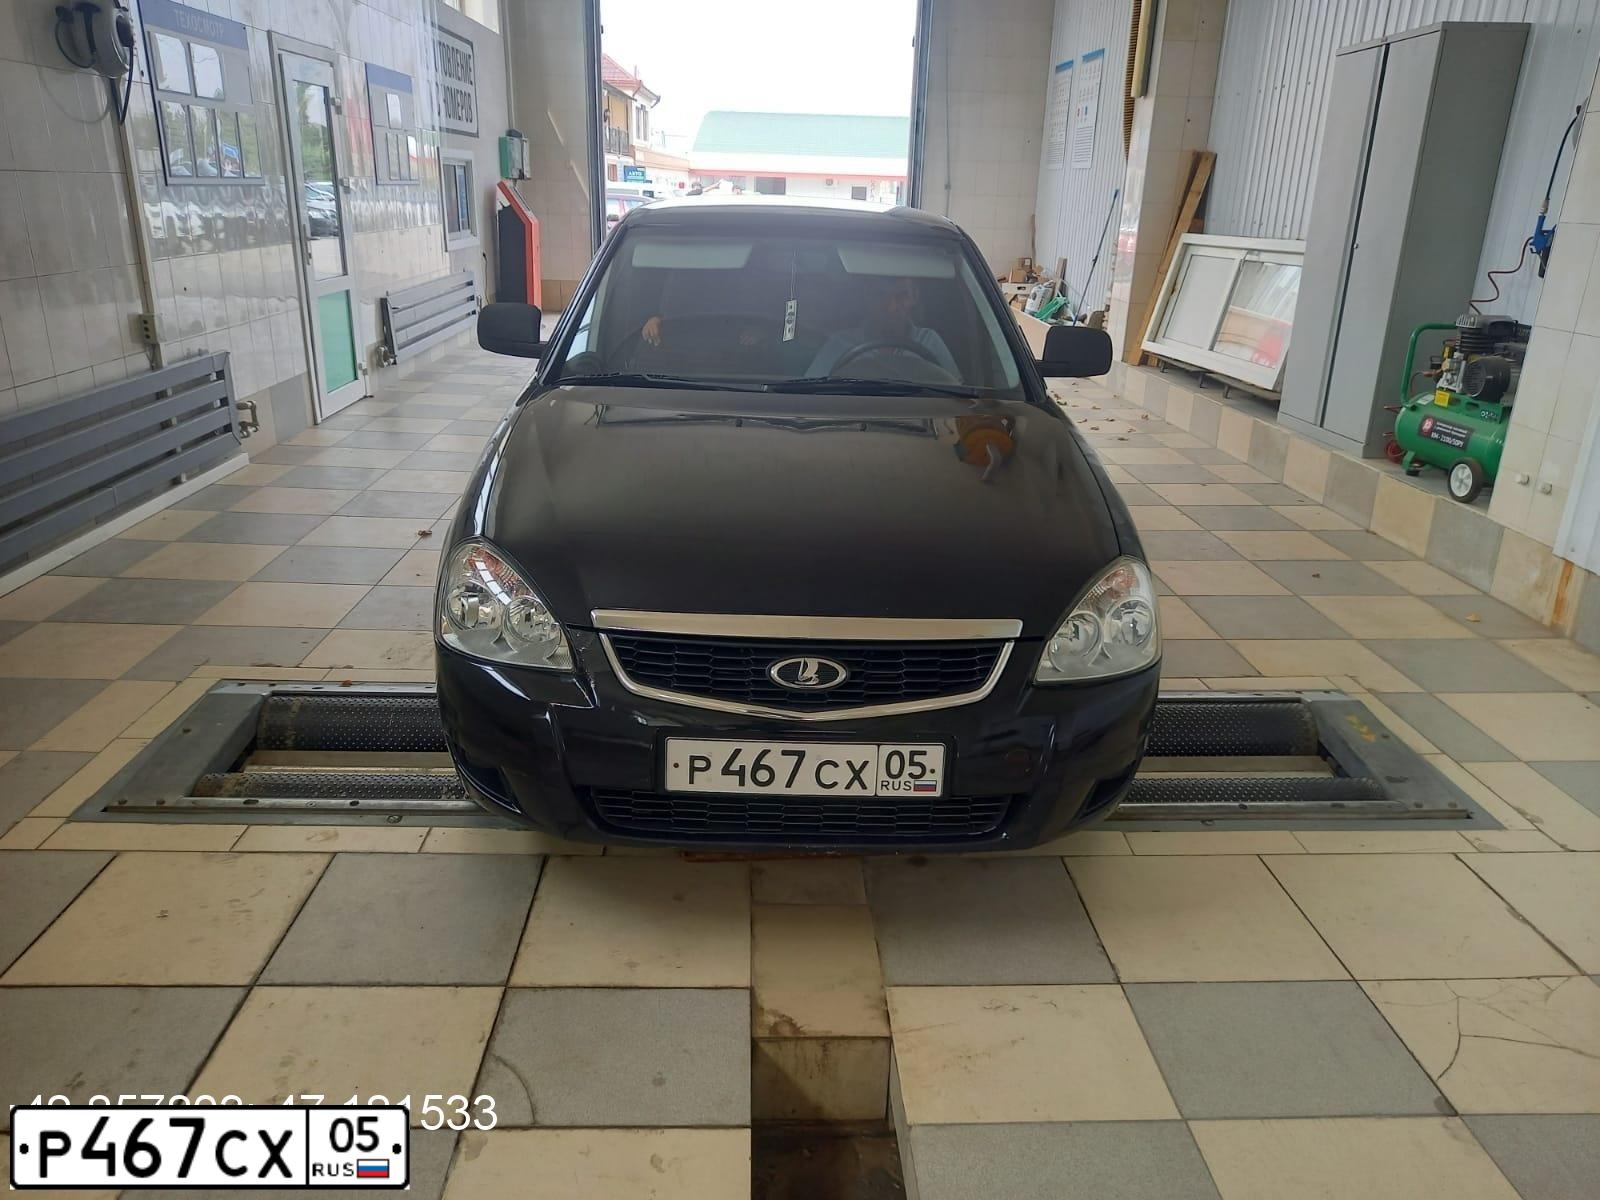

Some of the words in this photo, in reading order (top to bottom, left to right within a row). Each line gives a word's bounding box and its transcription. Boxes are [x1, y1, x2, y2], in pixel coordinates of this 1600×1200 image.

[688, 748, 870, 790] Р467СХ
[885, 750, 928, 780] 05
[880, 780, 912, 791] RUS
